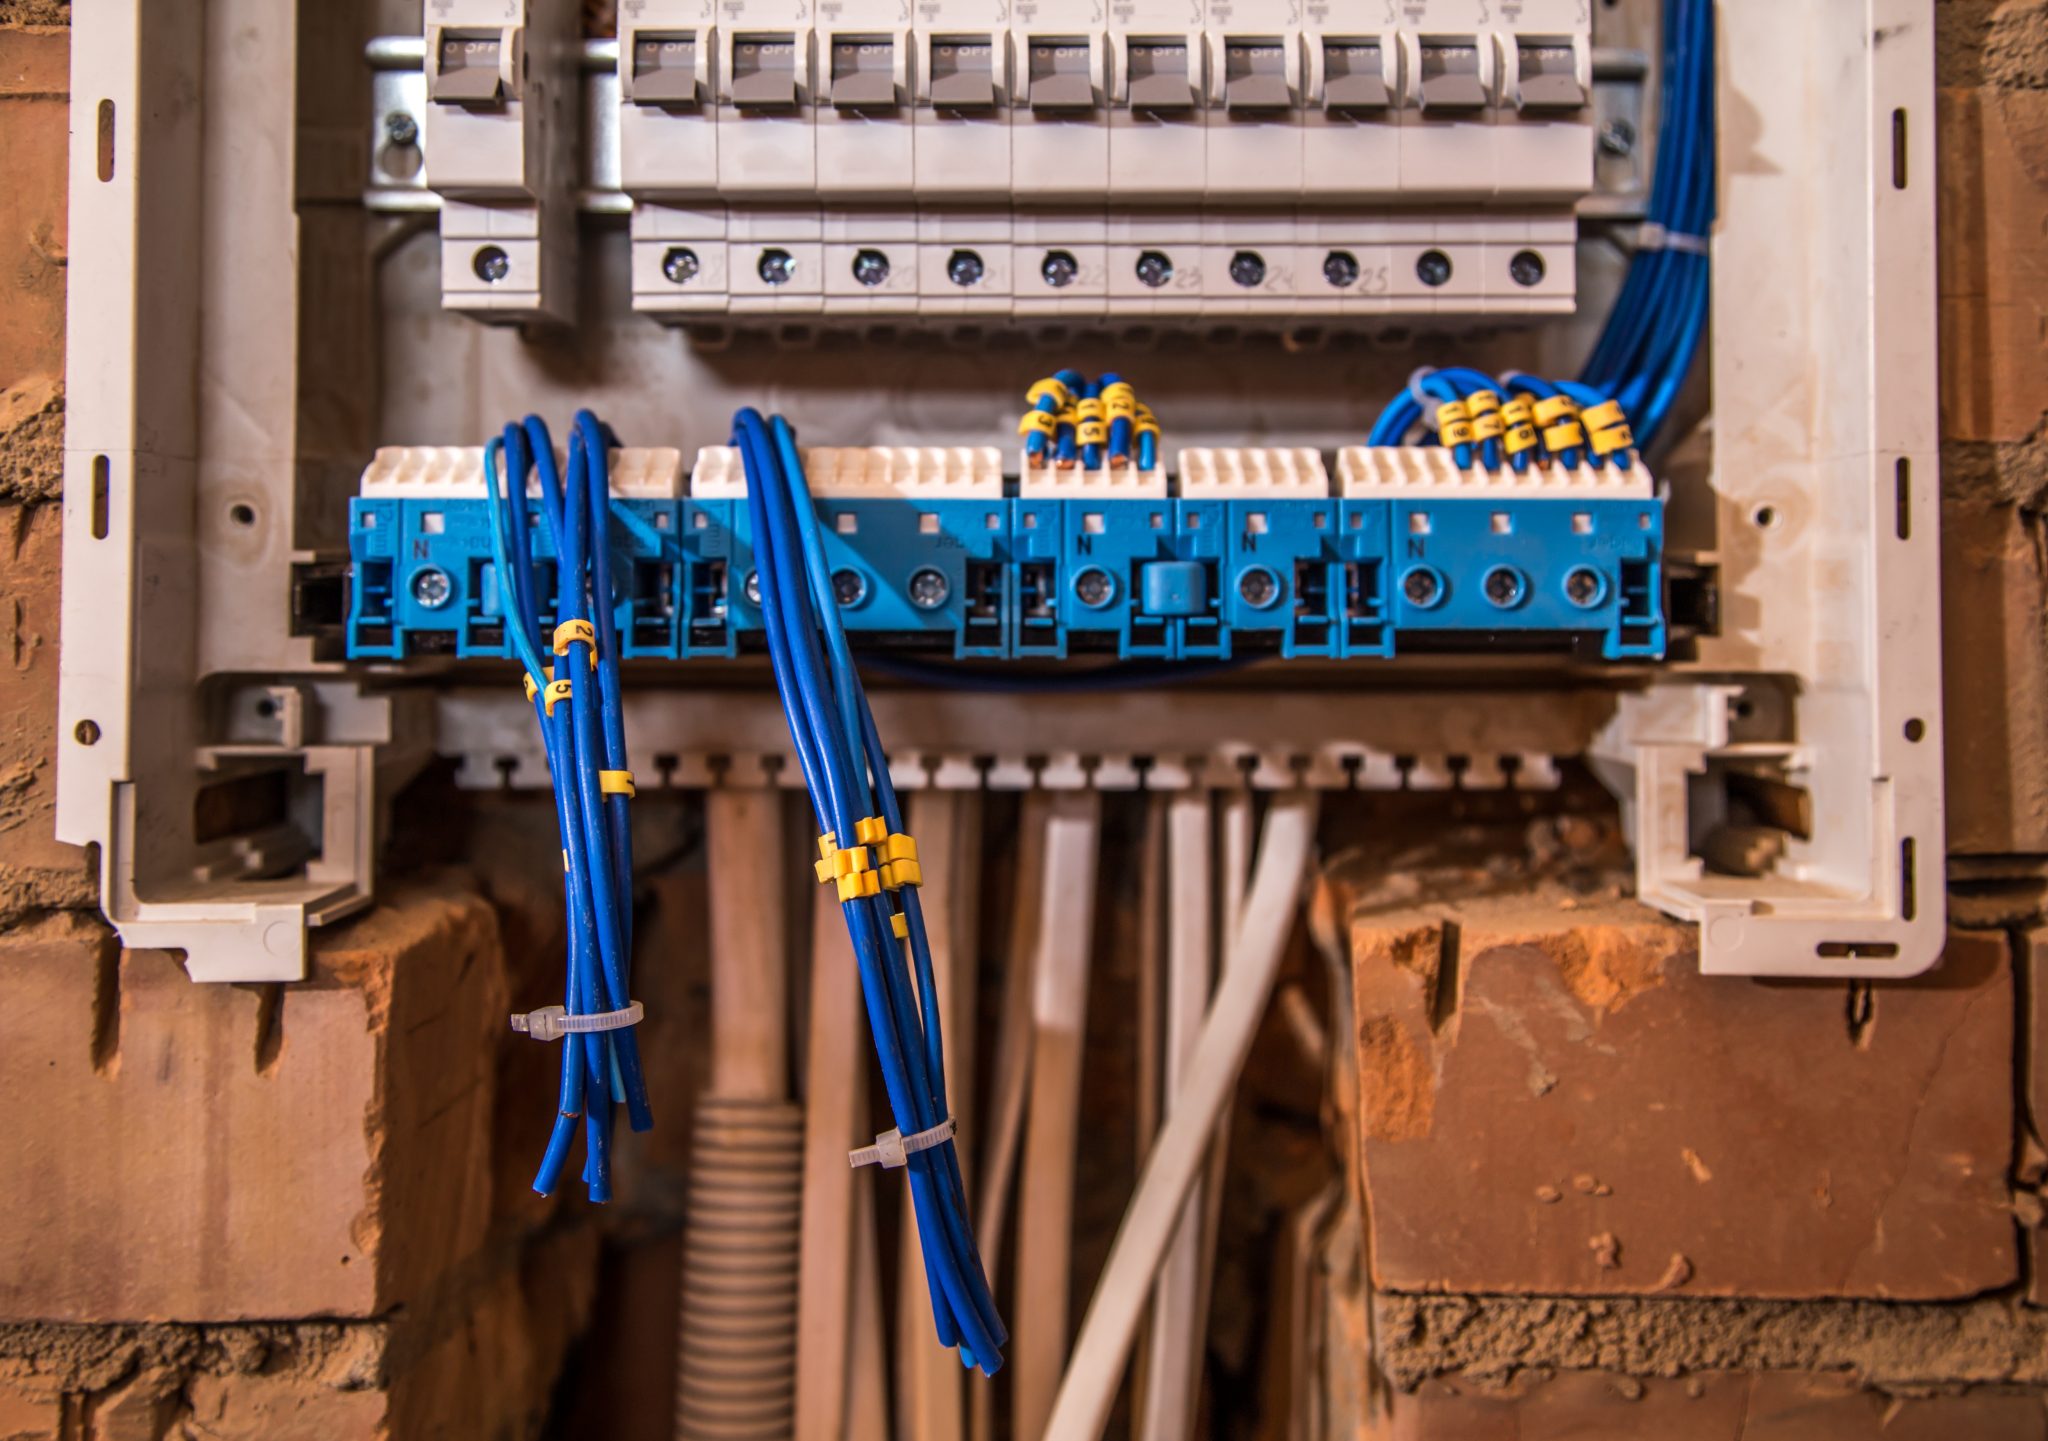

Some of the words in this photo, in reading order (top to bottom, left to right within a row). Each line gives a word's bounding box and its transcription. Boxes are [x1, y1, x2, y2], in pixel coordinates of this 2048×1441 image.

[464, 42, 498, 54] OFF
[761, 44, 795, 55] OFF
[859, 45, 894, 55] OFF
[958, 46, 992, 57] OFF
[1055, 47, 1089, 57] OFF
[1151, 47, 1186, 57] OFF
[1250, 48, 1282, 58] OFF
[1347, 48, 1379, 58] OFF
[1440, 48, 1472, 58] OFF
[884, 265, 914, 289] 20
[980, 264, 1006, 290] 21
[1077, 264, 1105, 287] 22
[1174, 266, 1203, 289] 23
[1264, 265, 1294, 292] 24
[1358, 265, 1389, 294] 25
[1077, 534, 1093, 556] N
[1242, 532, 1257, 553] N
[1407, 538, 1425, 559] N
[413, 538, 430, 560] N
[576, 625, 593, 637] 2
[555, 683, 571, 694] 5
